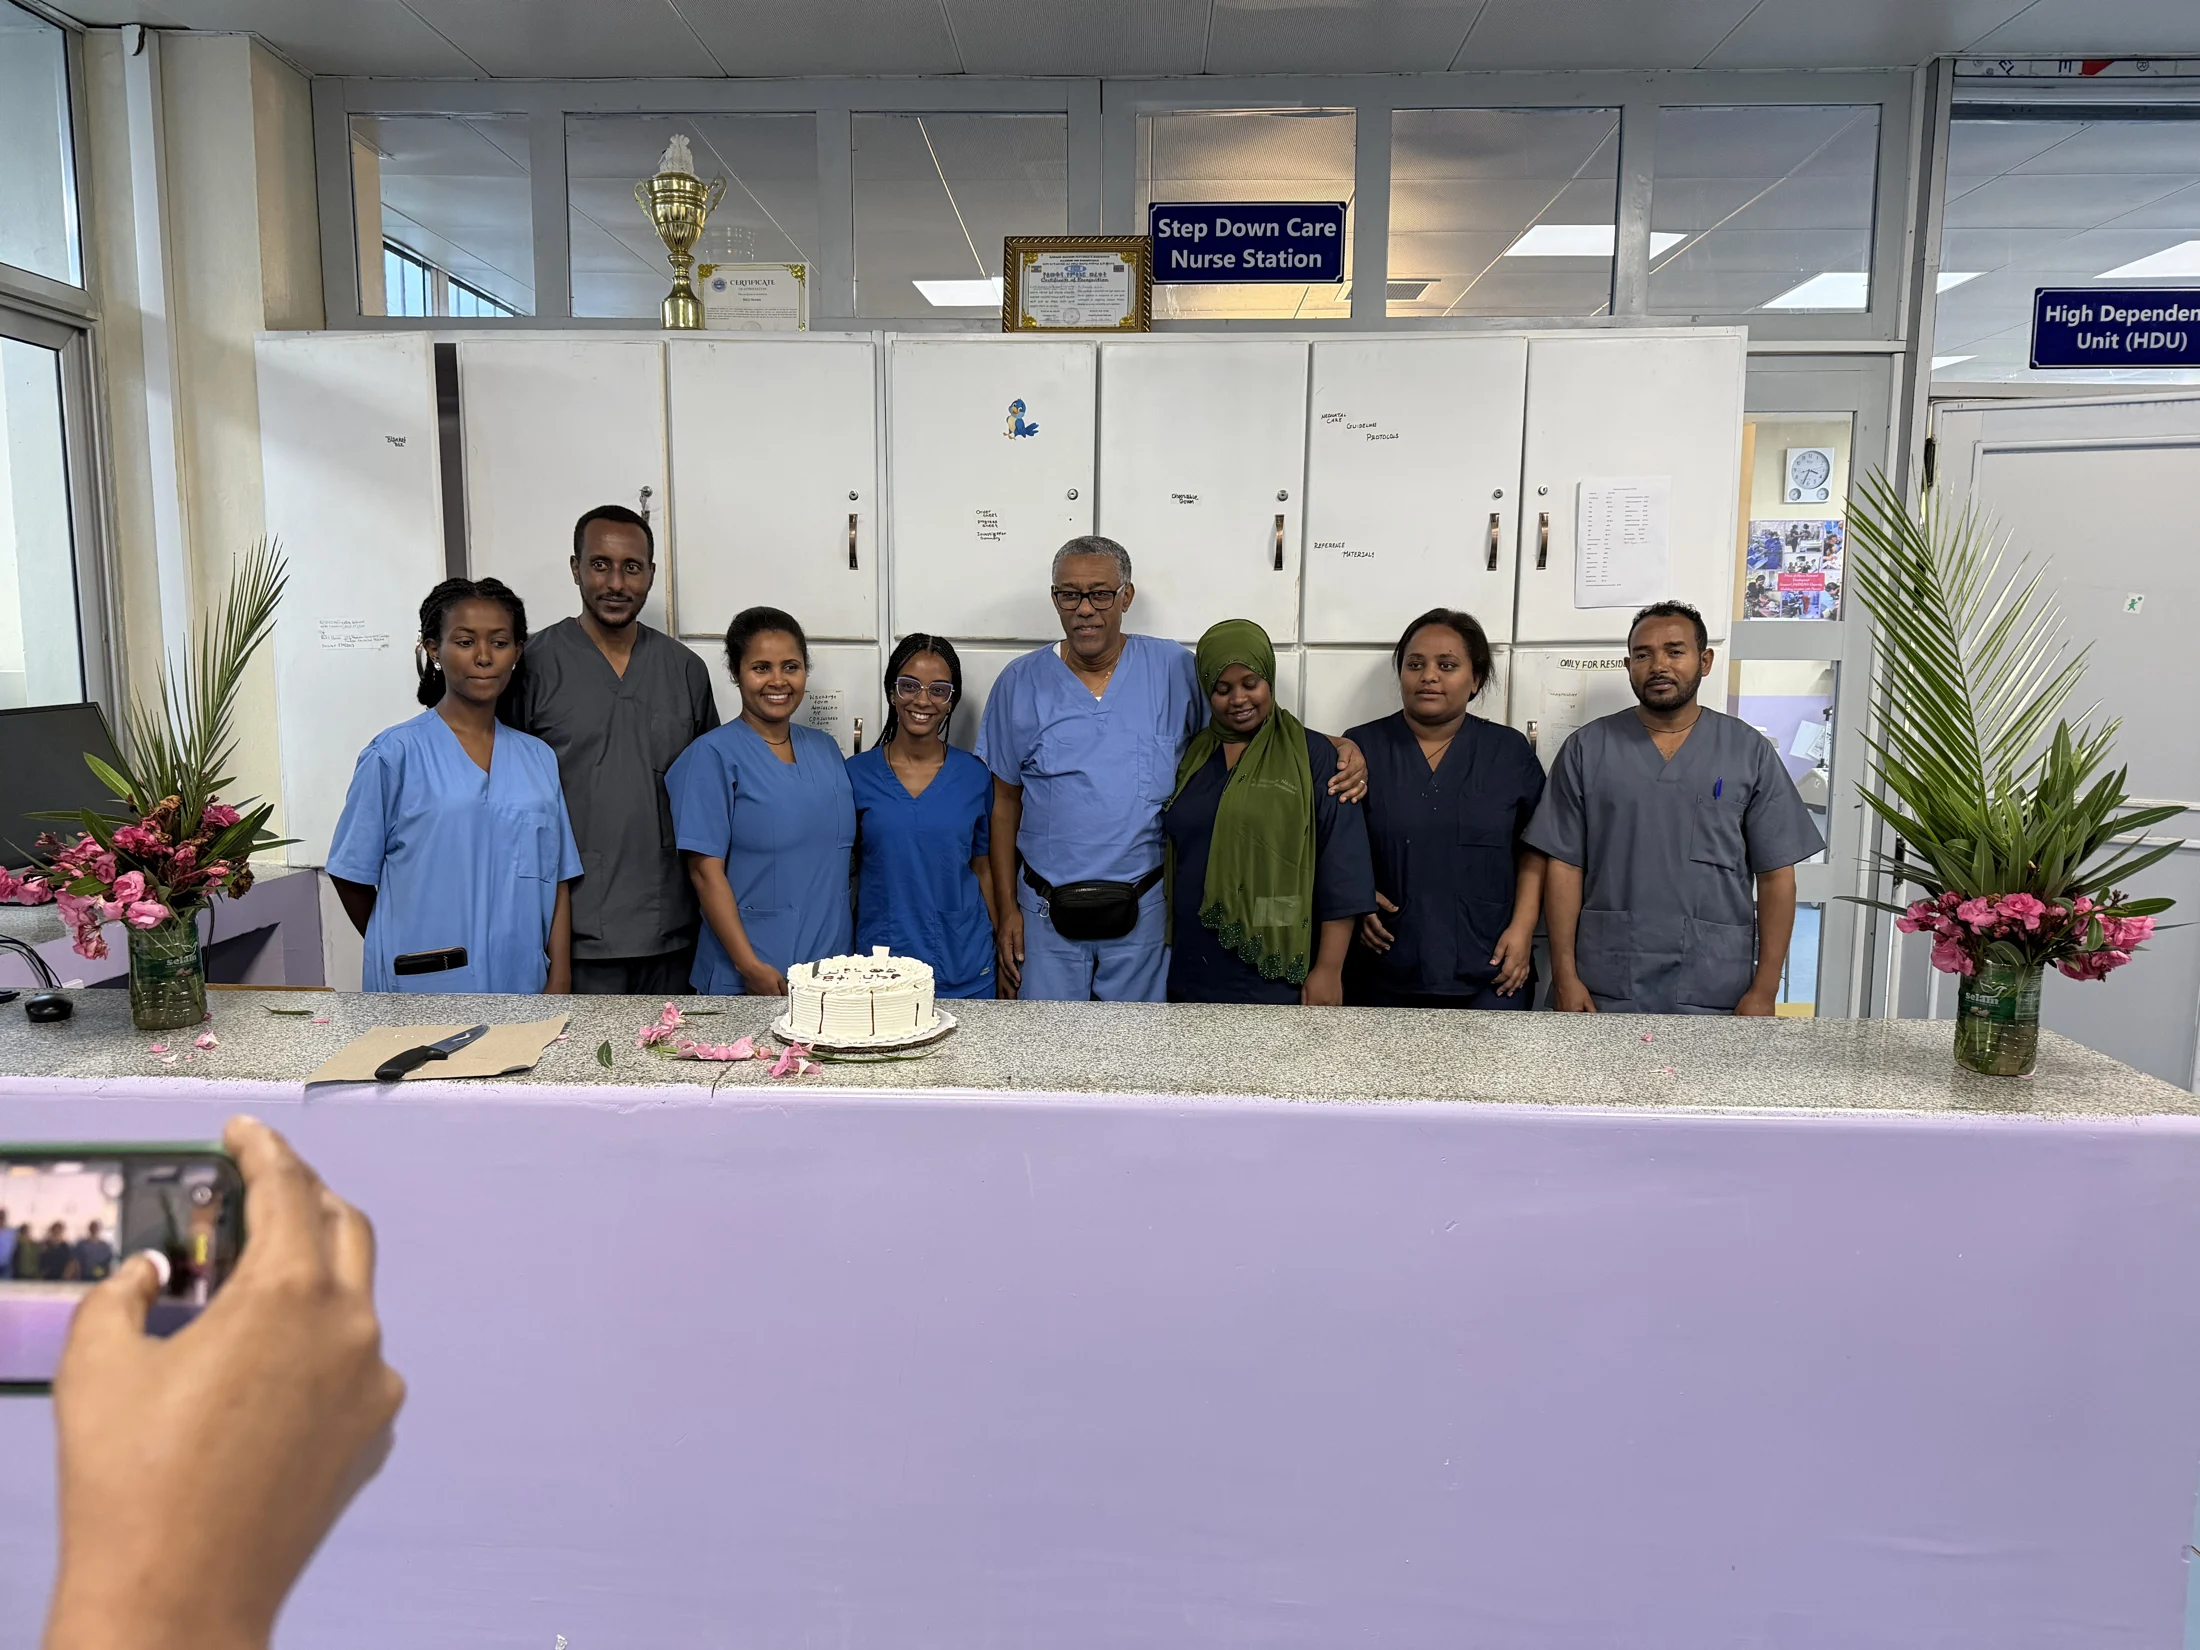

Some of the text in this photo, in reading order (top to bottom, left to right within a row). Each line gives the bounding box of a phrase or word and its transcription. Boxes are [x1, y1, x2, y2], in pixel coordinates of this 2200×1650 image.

[1158, 218, 1336, 242] Step Down Care
[1172, 248, 1322, 268] Nurse Station
[2045, 304, 2200, 327] High Dependen
[2077, 332, 2187, 352] Unit (HDU)
[1560, 659, 1580, 669] ONLY
[1582, 660, 1598, 668] FOR
[166, 954, 197, 965] selam
[1966, 992, 2000, 1004] selam
